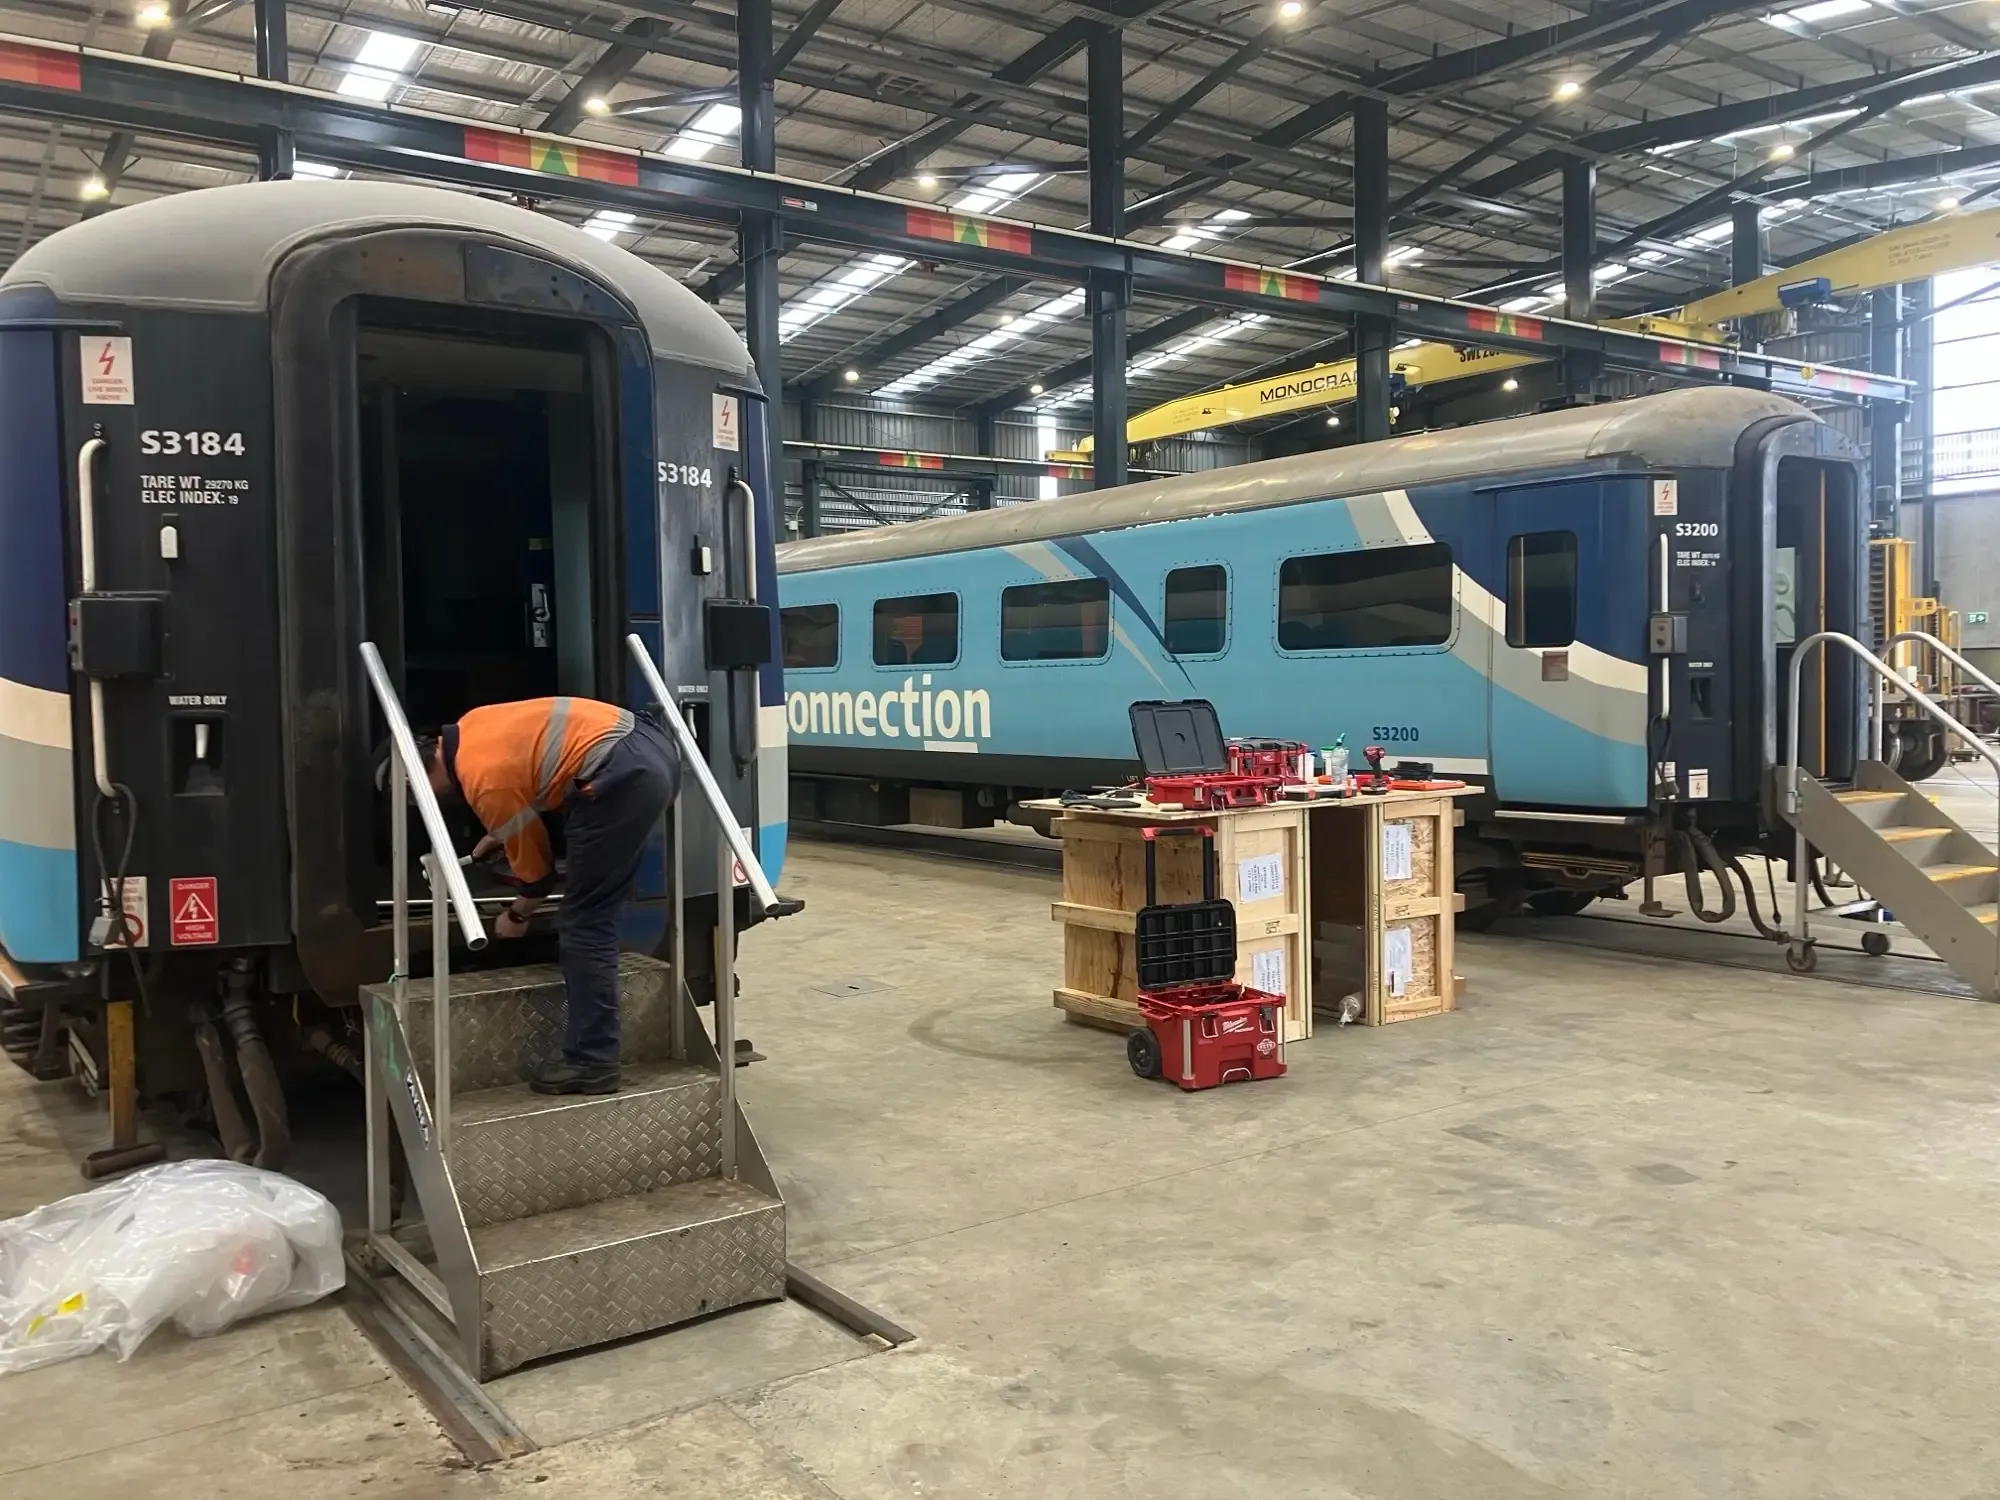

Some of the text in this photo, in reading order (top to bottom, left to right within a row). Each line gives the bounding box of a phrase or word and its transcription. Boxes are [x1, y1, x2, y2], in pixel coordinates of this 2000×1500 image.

[140, 429, 246, 456] S3184
[140, 475, 176, 489] TARE
[179, 475, 201, 489] WT
[234, 480, 249, 490] KG
[657, 461, 713, 488] S3184
[141, 490, 176, 504] ELEC
[179, 490, 225, 504] INDEX:
[1675, 523, 1719, 537] S3200
[784, 674, 991, 738] onnection
[1372, 726, 1419, 742] S3200
